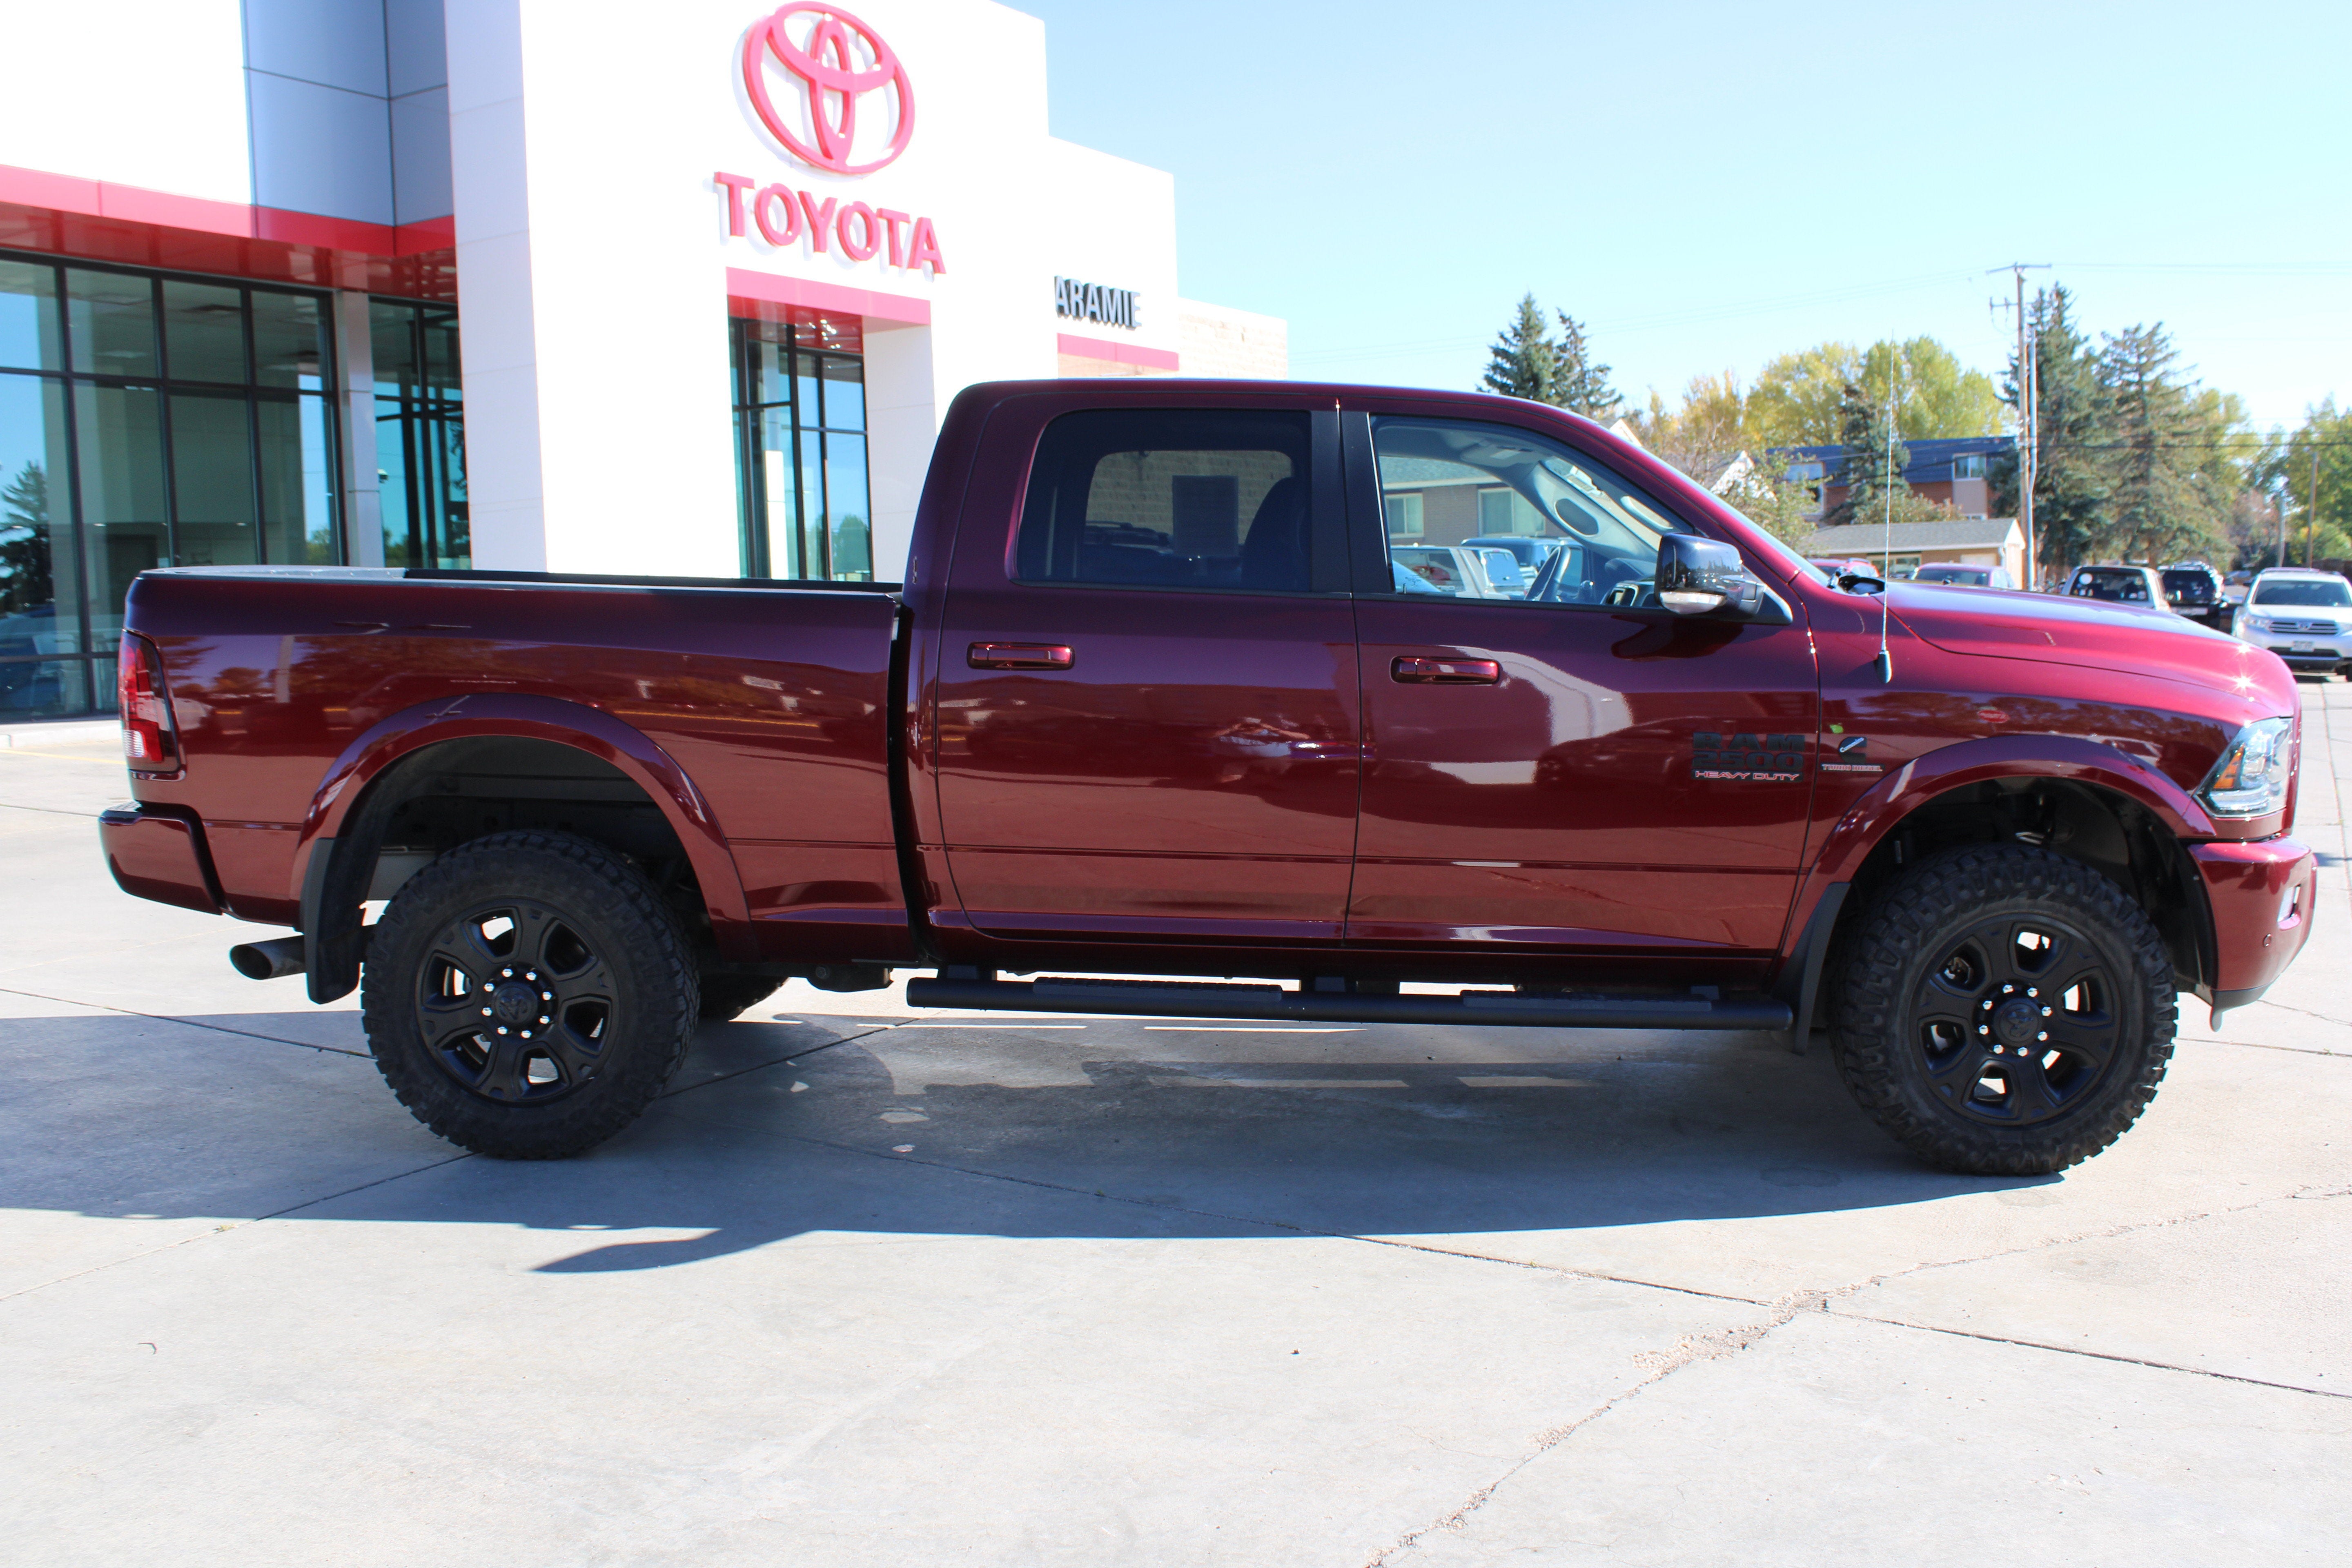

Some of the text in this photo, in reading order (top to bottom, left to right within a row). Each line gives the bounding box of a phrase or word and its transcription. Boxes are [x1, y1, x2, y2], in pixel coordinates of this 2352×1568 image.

[713, 171, 947, 274] TOYOTA
[1693, 732, 1806, 752] RAM
[1692, 751, 1805, 771] 2500
[1695, 771, 1800, 781] HEAVY DUTY
